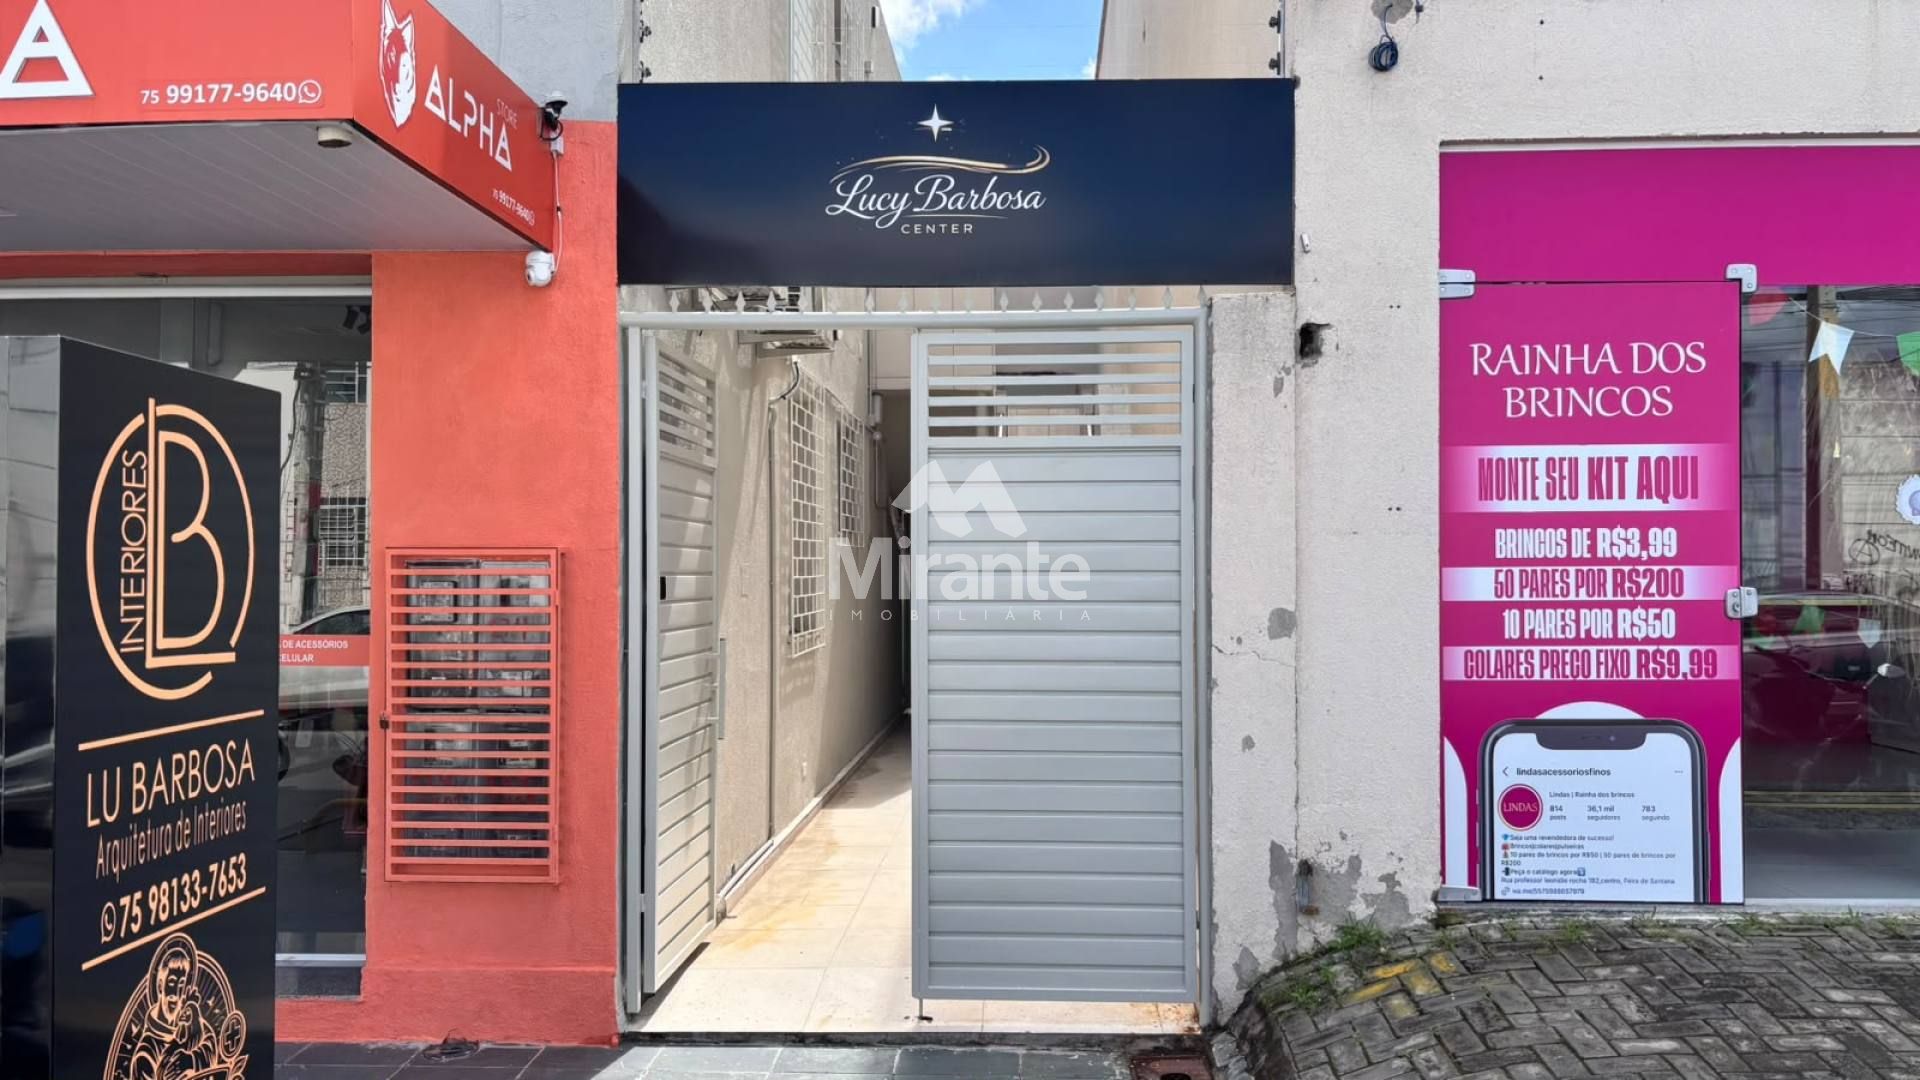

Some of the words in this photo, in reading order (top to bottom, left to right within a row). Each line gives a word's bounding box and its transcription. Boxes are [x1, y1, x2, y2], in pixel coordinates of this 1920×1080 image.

[141, 90, 160, 104] 75
[166, 82, 297, 104] 99177-9640
[424, 64, 513, 172] ALPHA
[496, 98, 518, 130] STORE
[825, 174, 912, 229] Lucy
[912, 174, 1047, 212] Barbosa
[900, 223, 974, 234] CENTER
[1469, 342, 1622, 376] RAINHA
[1629, 341, 1707, 374] DOS
[1503, 385, 1673, 418] BRINCOS
[1478, 457, 1539, 502] MONTE
[1545, 456, 1579, 501] SEU
[1587, 456, 1629, 500] KIT
[1636, 455, 1699, 504] AQUI
[120, 450, 147, 653] INTERIORES
[1495, 528, 1567, 558] BRINCOS
[1571, 528, 1591, 558] DE
[1596, 525, 1678, 561] R$3,99
[1494, 569, 1515, 599] 50
[1518, 568, 1570, 598] PARES
[1574, 568, 1608, 598] POR
[1612, 566, 1685, 600] R$200
[1503, 609, 1520, 639] 10
[1524, 609, 1576, 639] PARES
[1580, 608, 1613, 638] POR
[1617, 605, 1676, 641] R$50
[279, 653, 314, 662] ELULAR
[282, 640, 294, 649] DE
[1463, 649, 1535, 679] COLARES
[1595, 649, 1631, 678] FIXO
[87, 766, 121, 828] LU
[132, 738, 256, 815] BARBOSA
[1516, 767, 1611, 776] lindasacessoriosfinos
[1503, 802, 1538, 812] LINDAS
[95, 818, 172, 883] Arquitetura
[175, 809, 191, 852] de
[194, 796, 247, 846] Interiores
[119, 891, 142, 938] 75
[149, 852, 247, 925] 98133-7653
